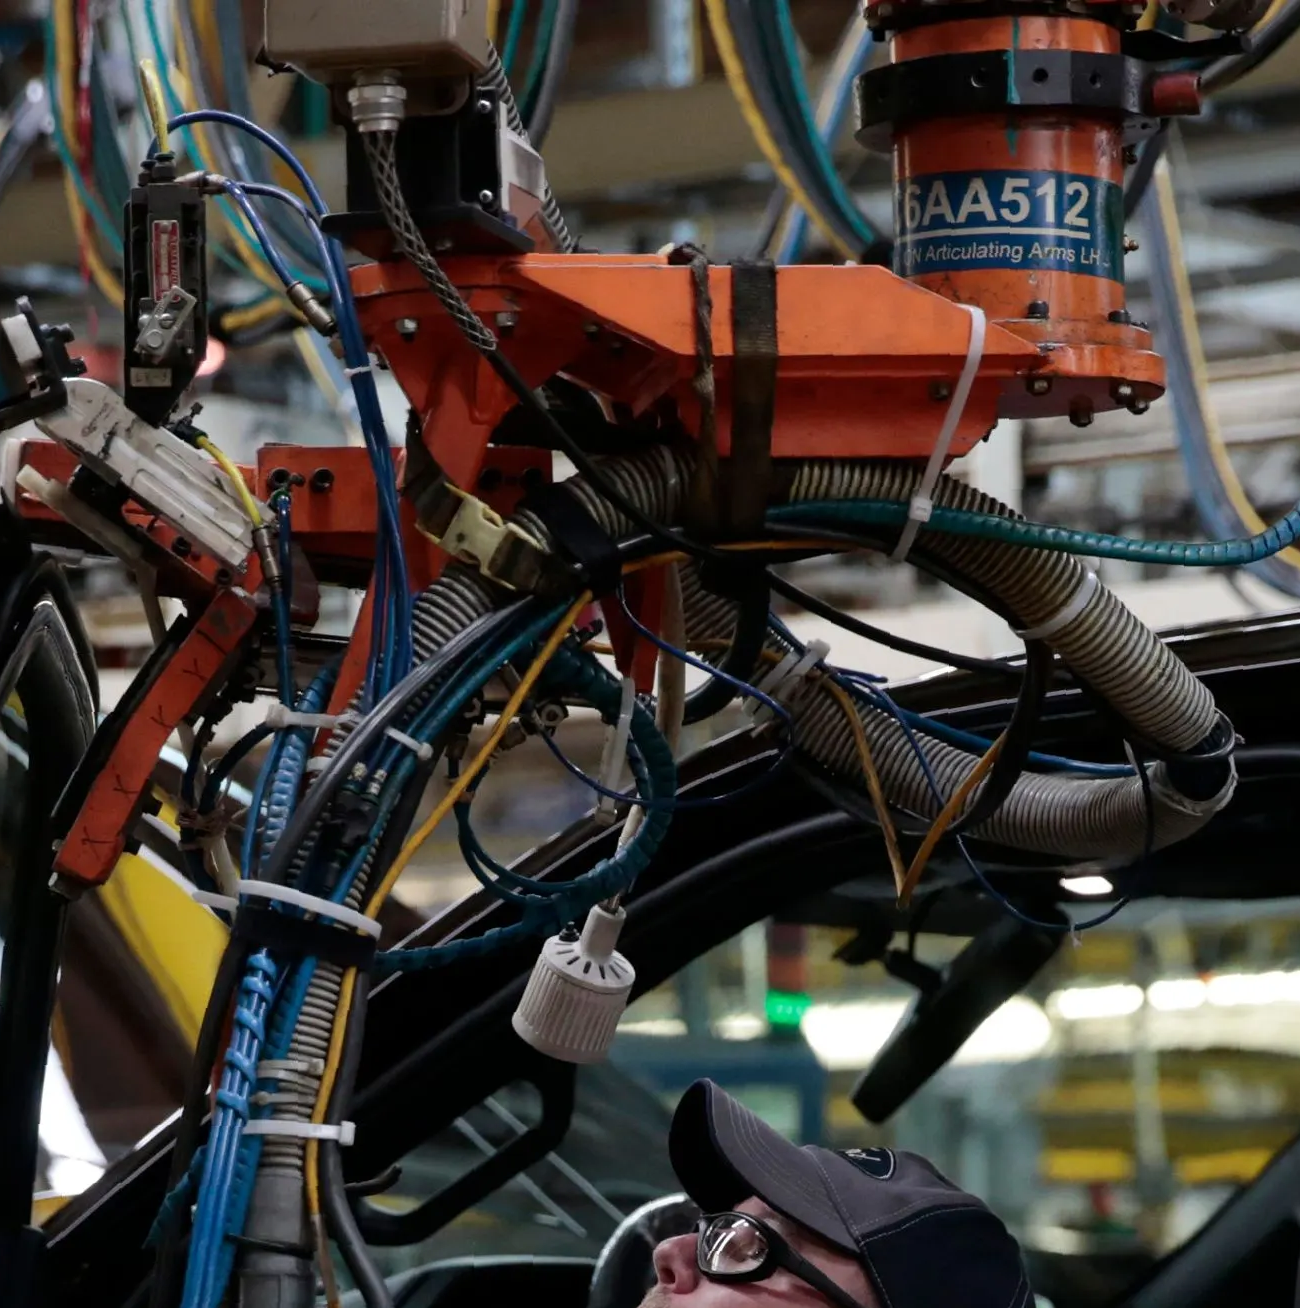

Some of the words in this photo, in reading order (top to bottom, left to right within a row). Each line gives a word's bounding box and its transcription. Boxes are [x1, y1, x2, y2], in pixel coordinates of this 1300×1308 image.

[903, 176, 1090, 229] 6AA512
[925, 240, 1024, 263] Articulating
[1028, 242, 1076, 263] Arms
